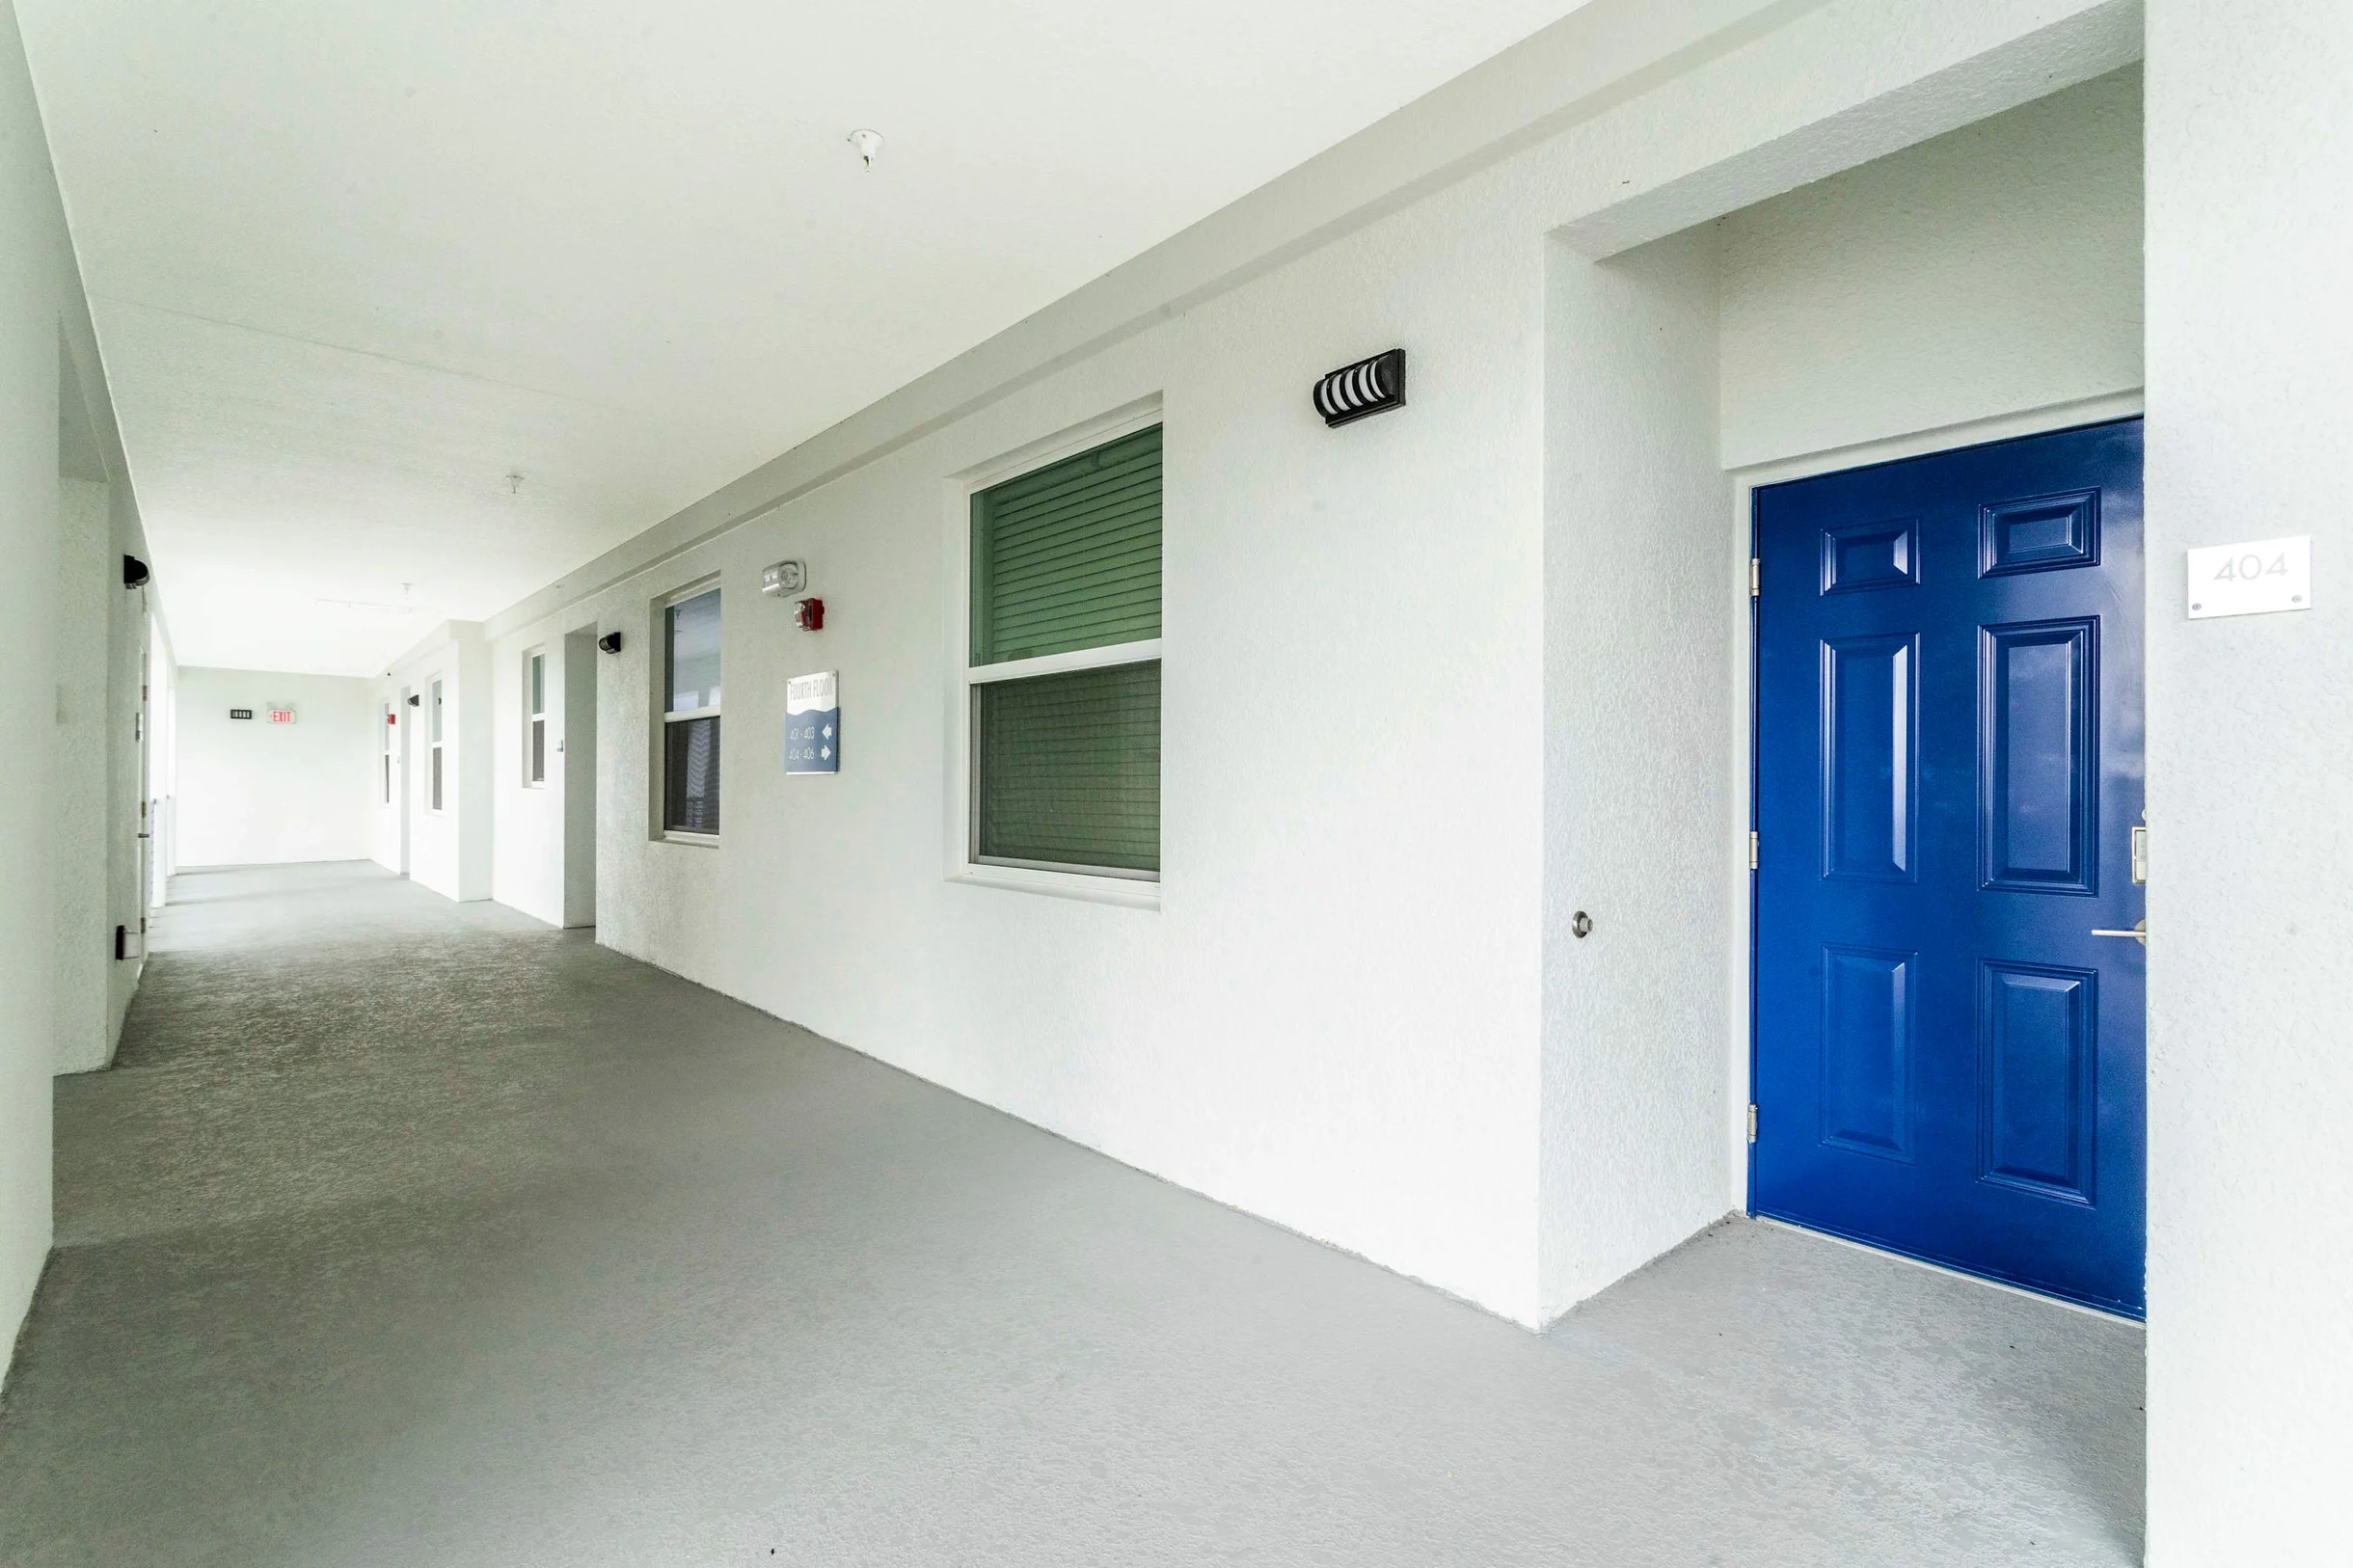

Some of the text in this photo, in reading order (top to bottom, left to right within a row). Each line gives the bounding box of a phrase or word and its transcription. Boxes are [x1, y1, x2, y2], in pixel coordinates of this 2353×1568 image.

[2213, 552, 2289, 581] 404
[790, 677, 833, 701] FOURTH FLOOR
[273, 711, 291, 722] EXIT
[803, 726, 815, 740] 403
[789, 747, 799, 761] 404
[802, 746, 815, 760] 406
